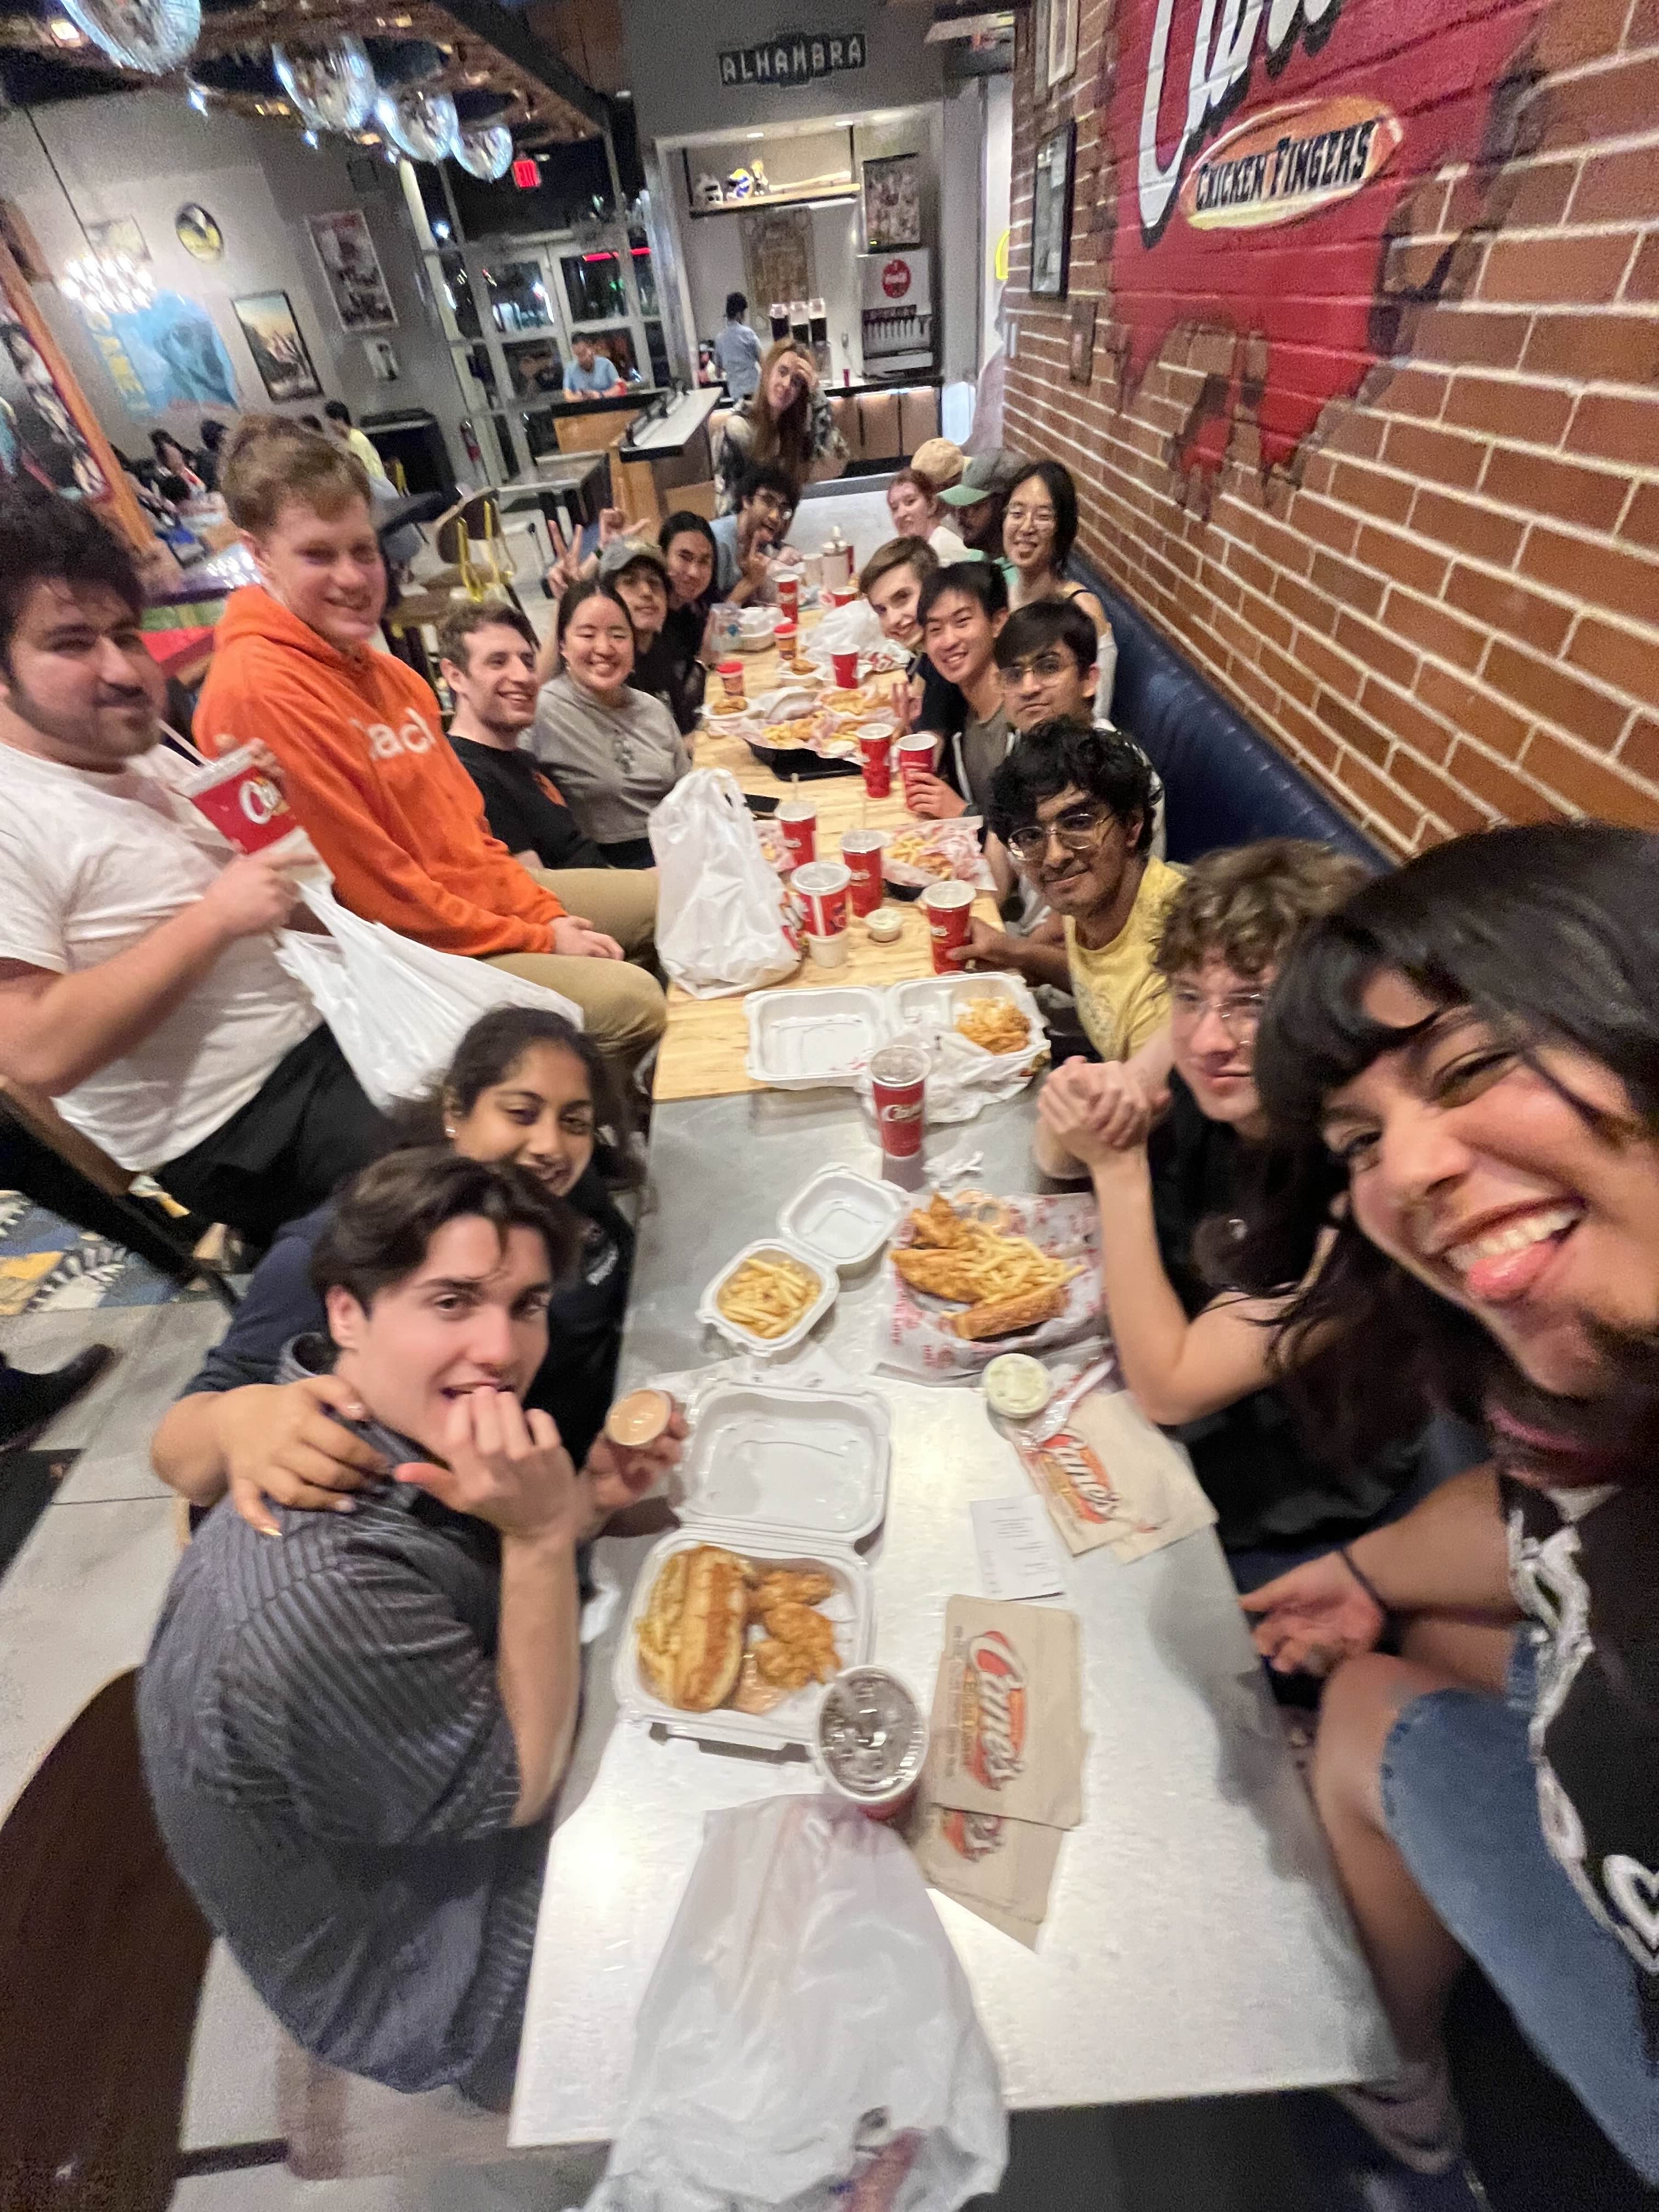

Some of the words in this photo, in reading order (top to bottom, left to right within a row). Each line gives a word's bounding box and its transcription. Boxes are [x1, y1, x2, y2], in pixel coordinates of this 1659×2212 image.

[722, 36, 861, 82] ALHAMBRA
[1197, 154, 1266, 211] CHICKEN
[1272, 121, 1376, 196] FINGERS
